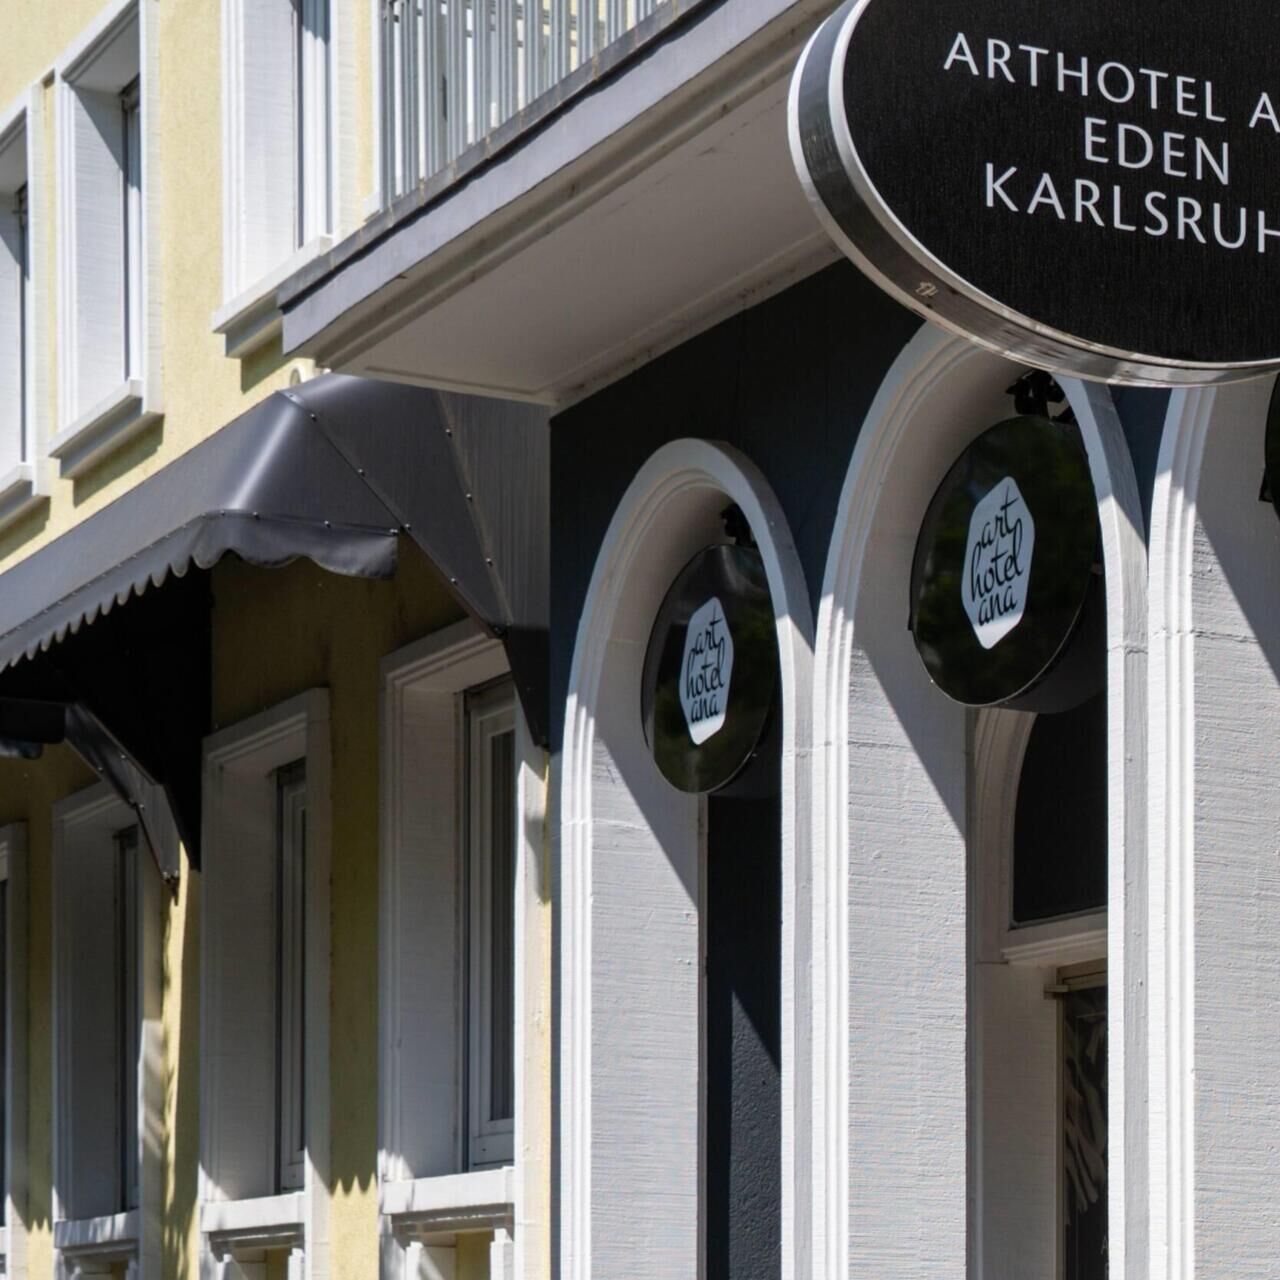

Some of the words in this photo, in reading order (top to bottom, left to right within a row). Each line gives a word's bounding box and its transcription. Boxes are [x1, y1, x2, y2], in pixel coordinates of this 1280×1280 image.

[943, 32, 1226, 123] ARTHOTEL
[1084, 117, 1230, 186] EDEN
[979, 485, 1021, 550] art
[970, 517, 1024, 603] hotel
[693, 605, 724, 655] art
[977, 585, 1018, 627] ana
[685, 637, 725, 700] hotel
[690, 695, 721, 724] ana
